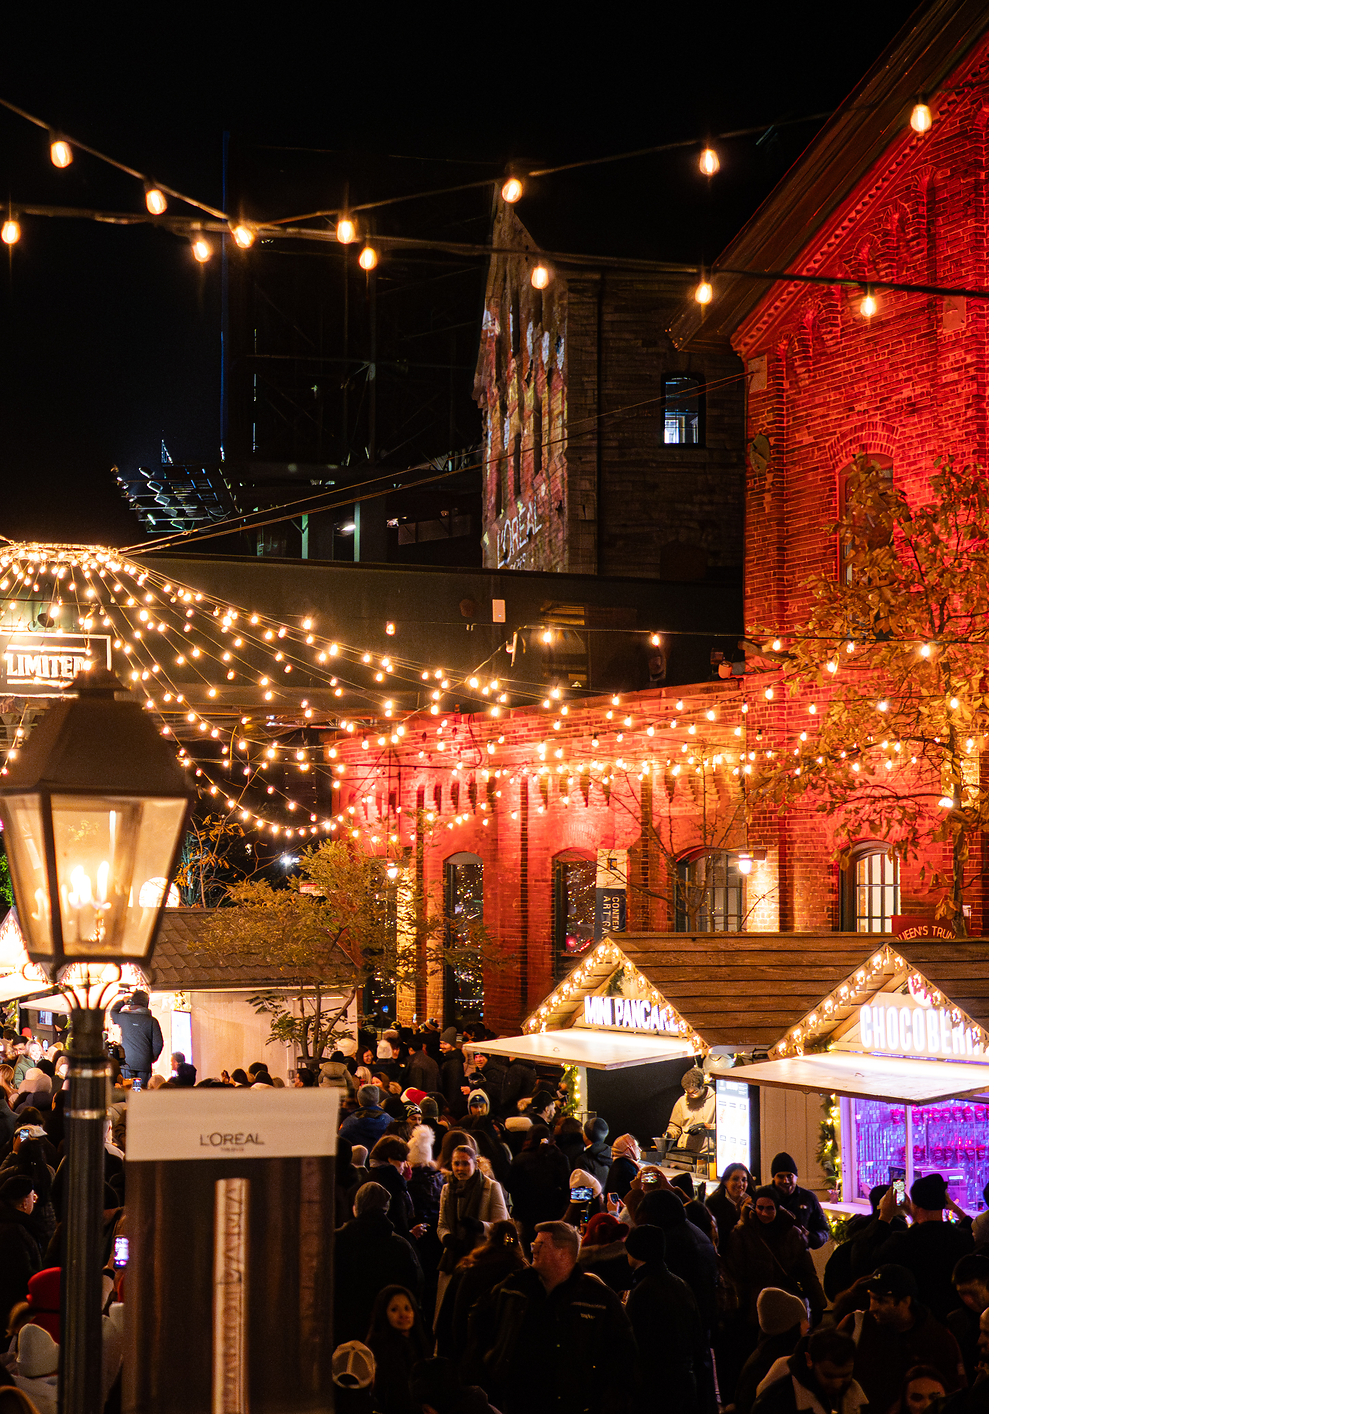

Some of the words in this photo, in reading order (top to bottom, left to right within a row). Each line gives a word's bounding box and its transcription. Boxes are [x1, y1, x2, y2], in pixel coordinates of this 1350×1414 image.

[603, 895, 611, 916] ART
[601, 920, 611, 939] GA
[896, 925, 929, 940] UEEN'S
[584, 996, 613, 1026] MINI
[860, 1004, 989, 1056] CHOCOBER
